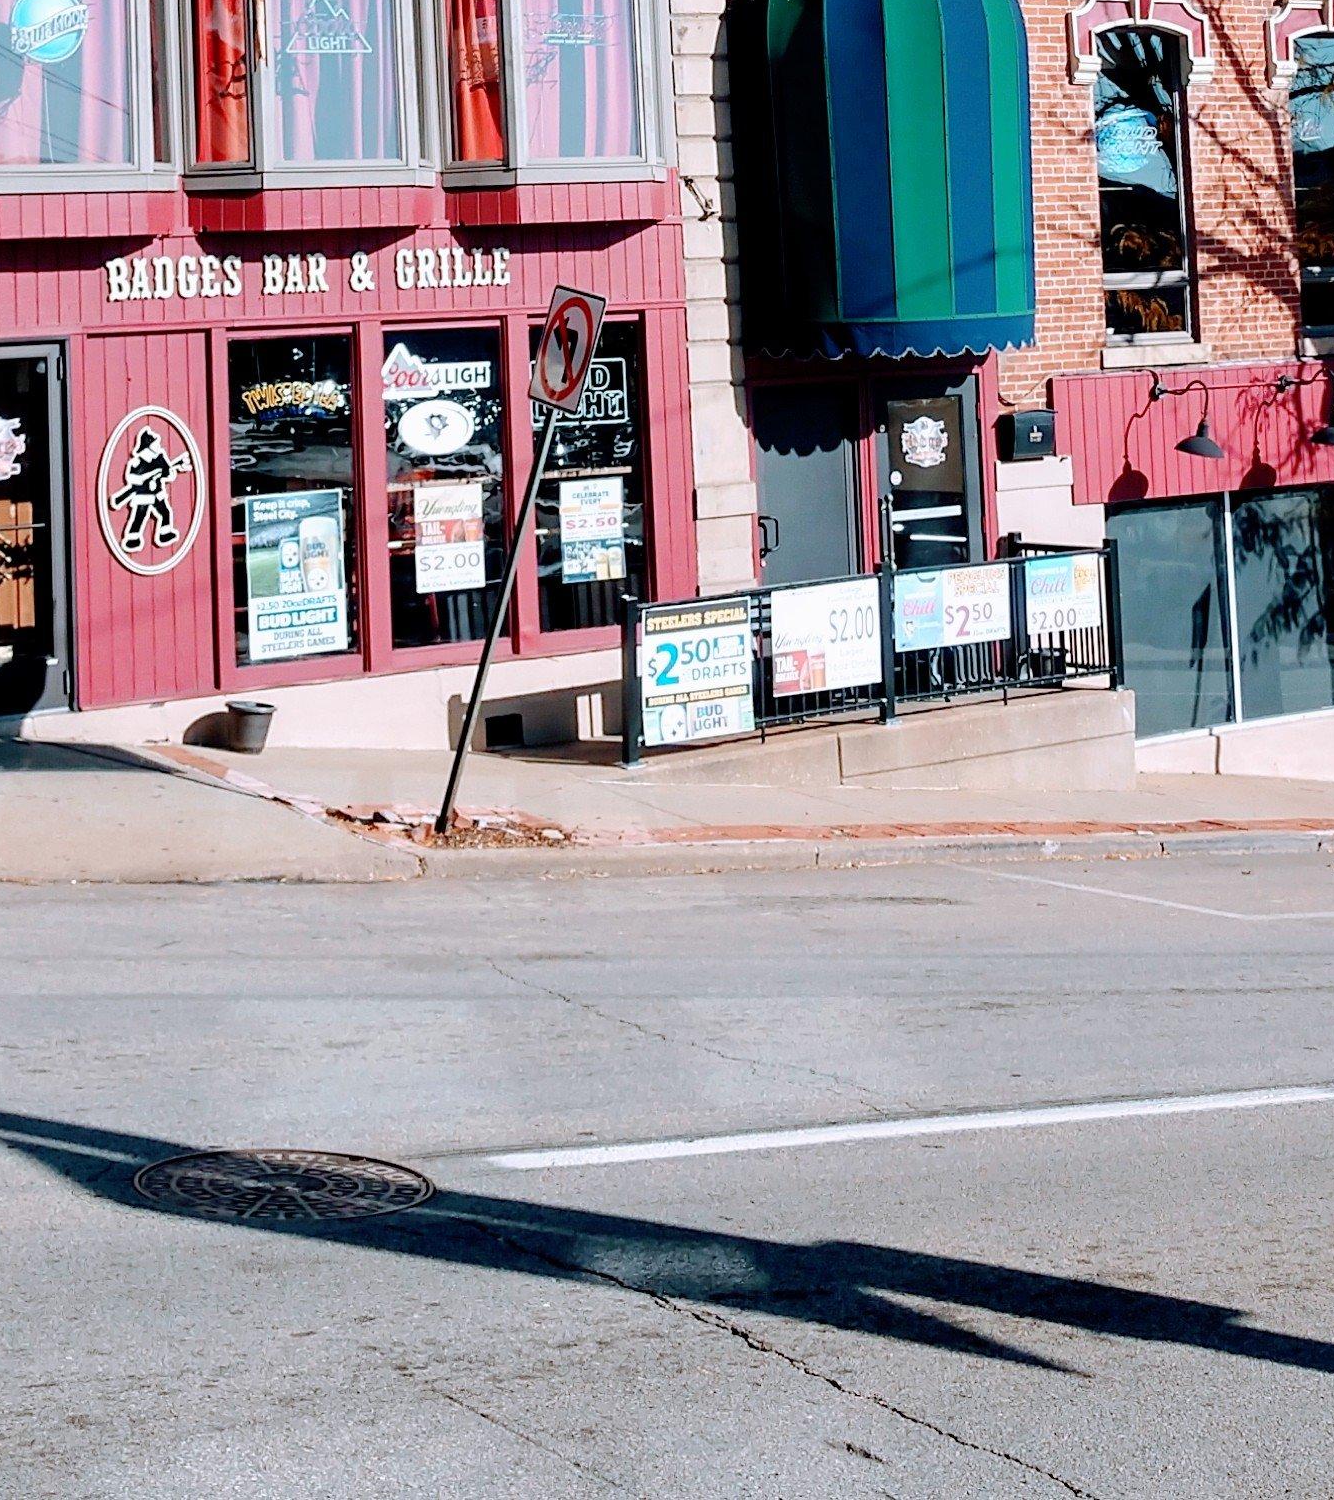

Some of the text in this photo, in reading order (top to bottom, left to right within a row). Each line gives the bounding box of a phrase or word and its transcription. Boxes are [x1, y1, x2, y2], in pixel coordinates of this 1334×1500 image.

[308, 35, 348, 50] LIGHT
[105, 246, 512, 302] BADGES BAR & GRILLE
[534, 389, 624, 419] LHT
[571, 491, 609, 499] CELEBRATE
[565, 516, 618, 530] $2.50
[419, 552, 481, 573] $2.00
[258, 608, 337, 630] BUD LIGHT
[647, 607, 747, 632] STEELERS SPECIAL
[830, 605, 875, 644] $2.00
[1032, 608, 1077, 630] $2.00
[274, 627, 323, 641] DURING ALL
[261, 641, 305, 653] STEELERS
[692, 661, 747, 681] DRAFTS
[696, 704, 724, 718] BUD
[693, 715, 728, 732] LIGHT
